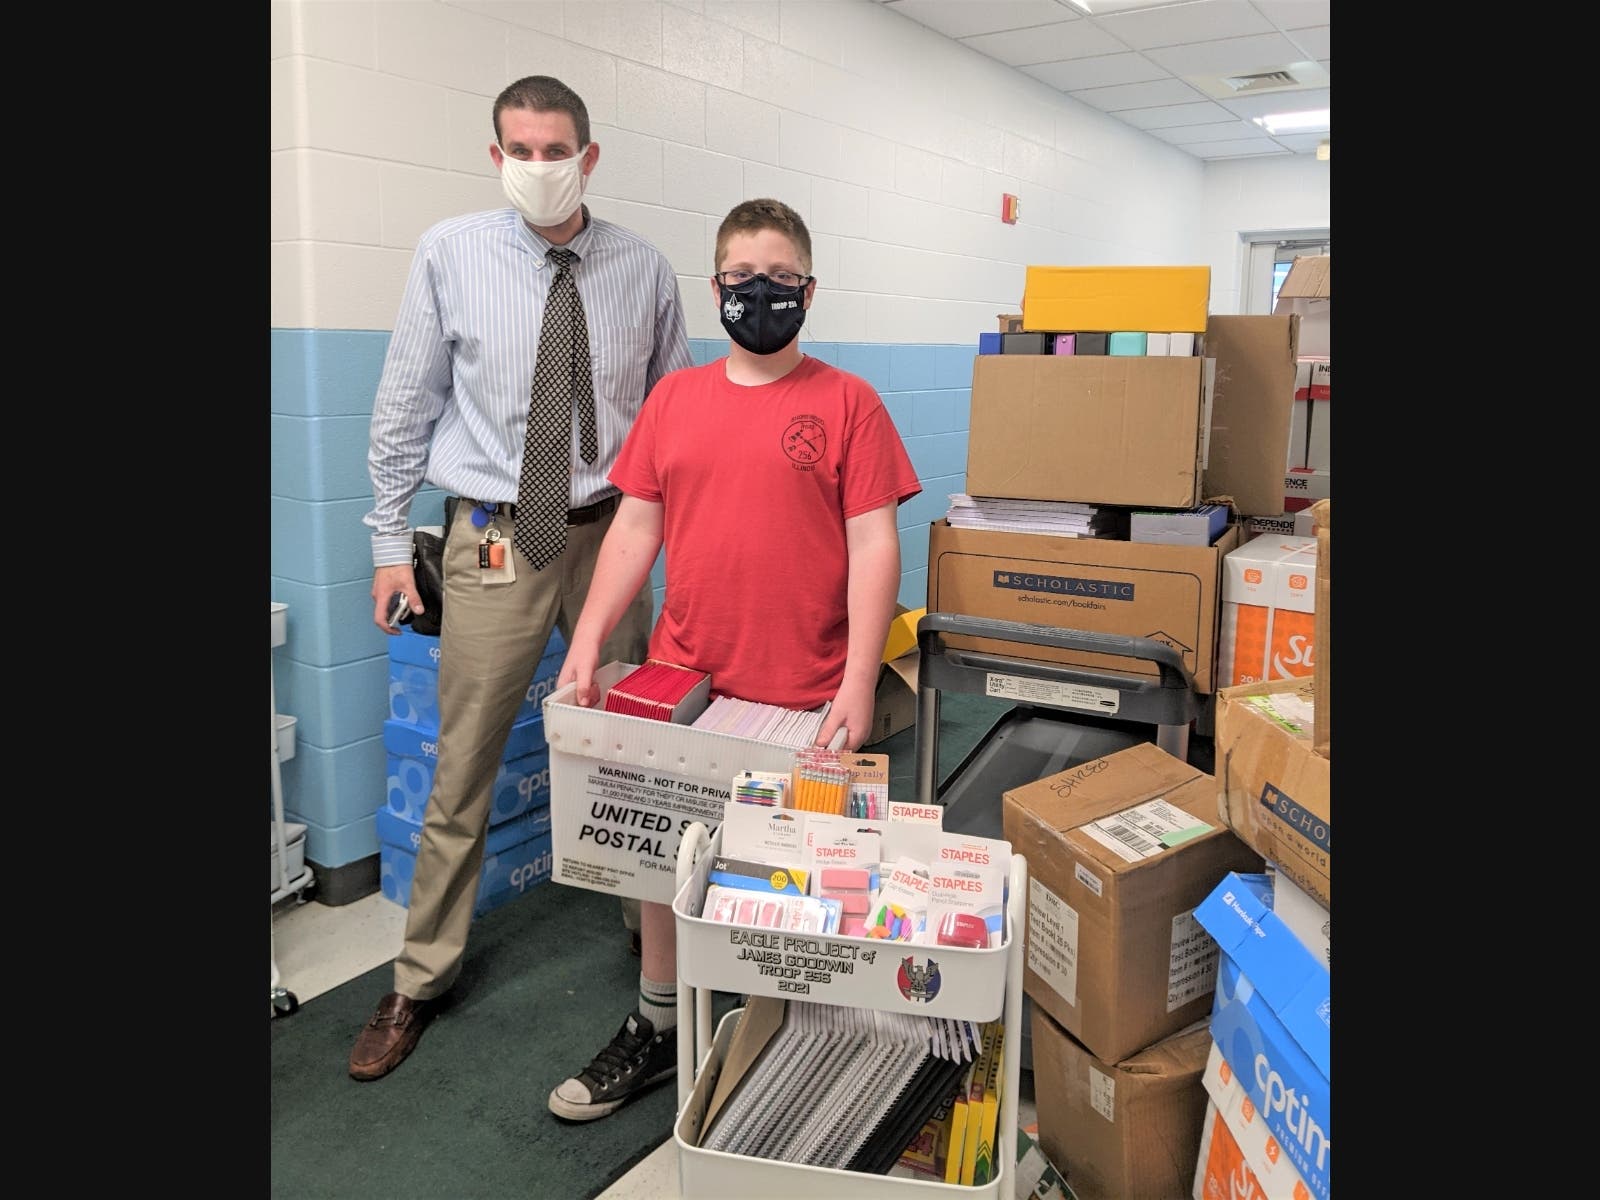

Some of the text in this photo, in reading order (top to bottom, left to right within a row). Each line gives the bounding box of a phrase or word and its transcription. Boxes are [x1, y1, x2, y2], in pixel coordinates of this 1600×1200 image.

[771, 302, 788, 311] TROOP
[1013, 575, 1131, 596] SCHOLASTIC
[1018, 594, 1106, 611] scholastic.com/bookfairs
[598, 765, 646, 783] WARNING
[654, 776, 675, 789] NOT
[677, 782, 699, 794] FOR
[702, 786, 731, 800] PRIVA
[616, 783, 641, 793] PENALTY
[642, 788, 656, 797] FOR
[656, 791, 675, 801] THEFT
[620, 792, 633, 800] FINE
[634, 794, 646, 803] AND
[651, 798, 672, 808] YEARS
[590, 801, 672, 833] UNITED
[892, 805, 939, 820] STAPLES
[767, 822, 796, 834] Martha
[578, 824, 666, 858] POSTAL
[816, 847, 856, 858] STAPLES
[941, 848, 990, 865] STAPLES
[639, 859, 657, 870] FOR
[715, 860, 727, 870] Jot
[892, 870, 929, 893] STAPLE
[933, 877, 983, 893] STAPLES
[730, 929, 877, 964] EAGLE PROJECT of
[737, 948, 854, 974] JAMES GOODWIN
[757, 963, 832, 983] TROOP 256
[777, 980, 810, 994] 2021
